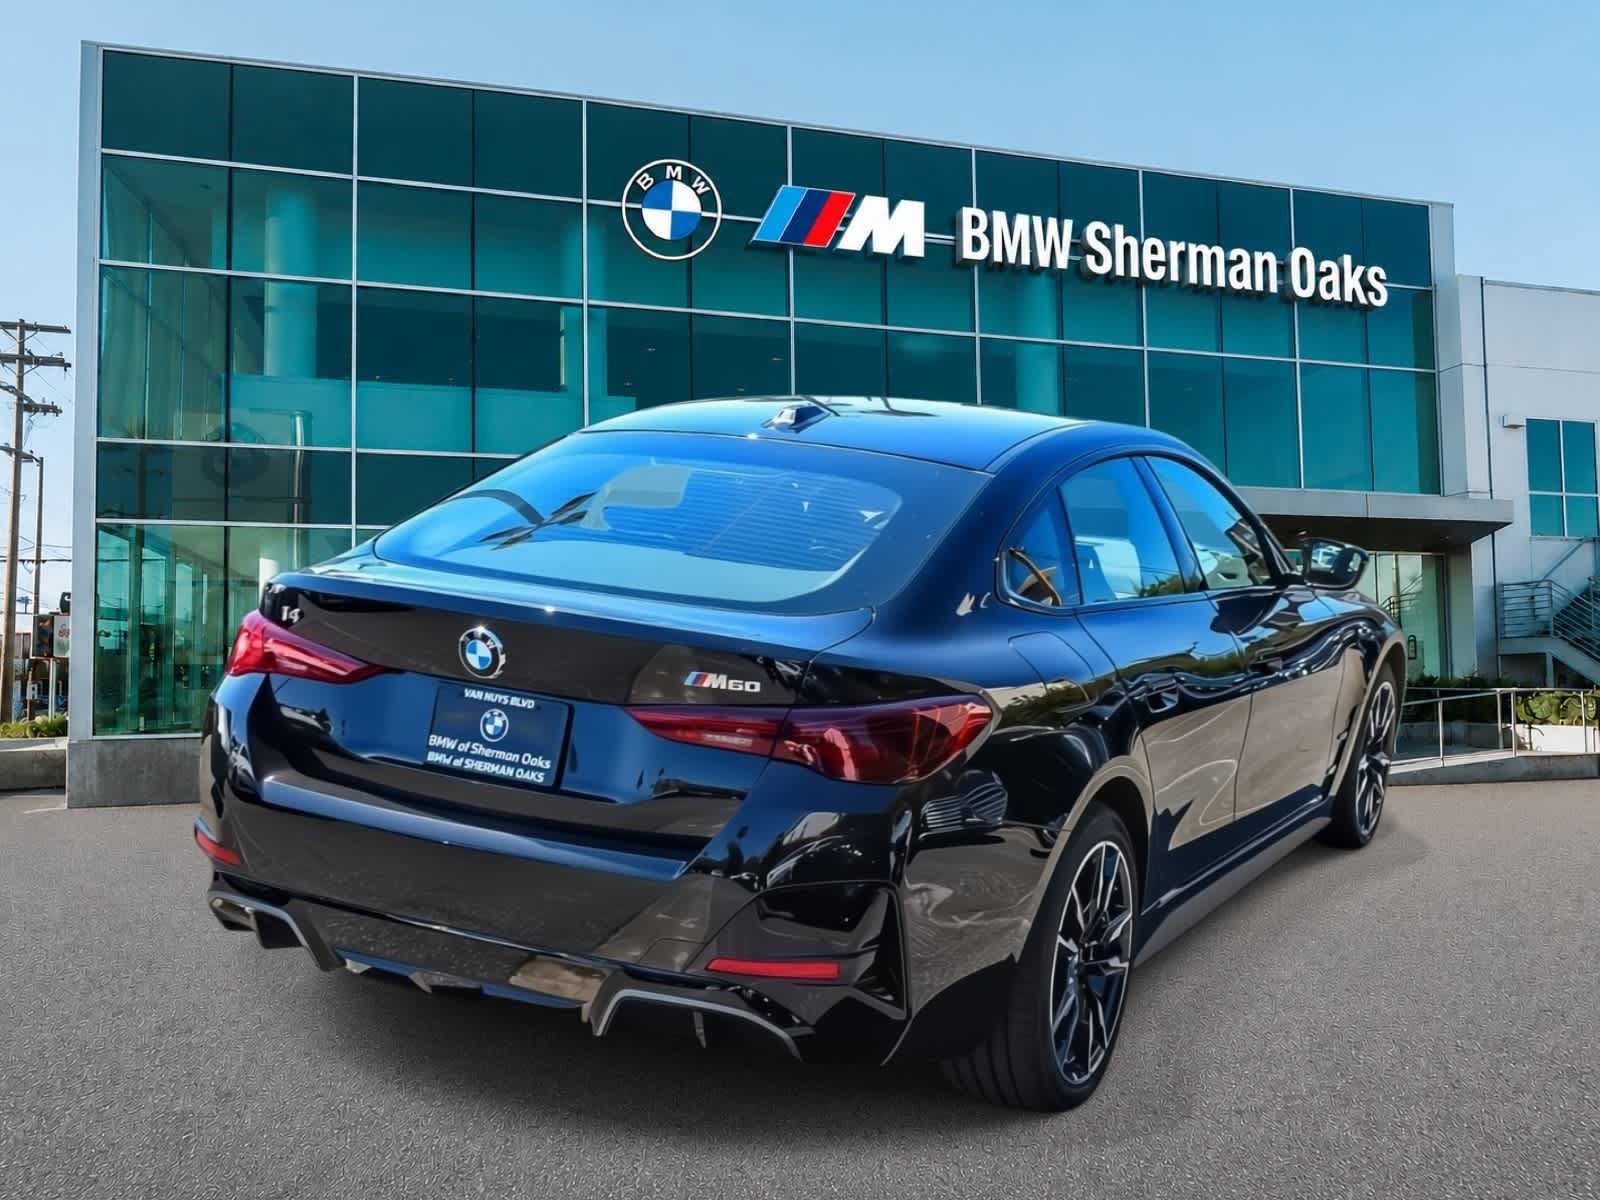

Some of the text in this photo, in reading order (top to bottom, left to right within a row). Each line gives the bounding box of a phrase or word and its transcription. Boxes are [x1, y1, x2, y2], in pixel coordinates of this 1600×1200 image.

[636, 164, 711, 195] BMW
[961, 206, 1388, 308] BMW Sherman Oaks
[464, 688, 535, 710] VAN NUYS BLVD
[428, 734, 457, 749] BMW
[427, 751, 452, 765] BMW
[464, 758, 515, 777] SHERMAN
[515, 768, 545, 783] OAKS
